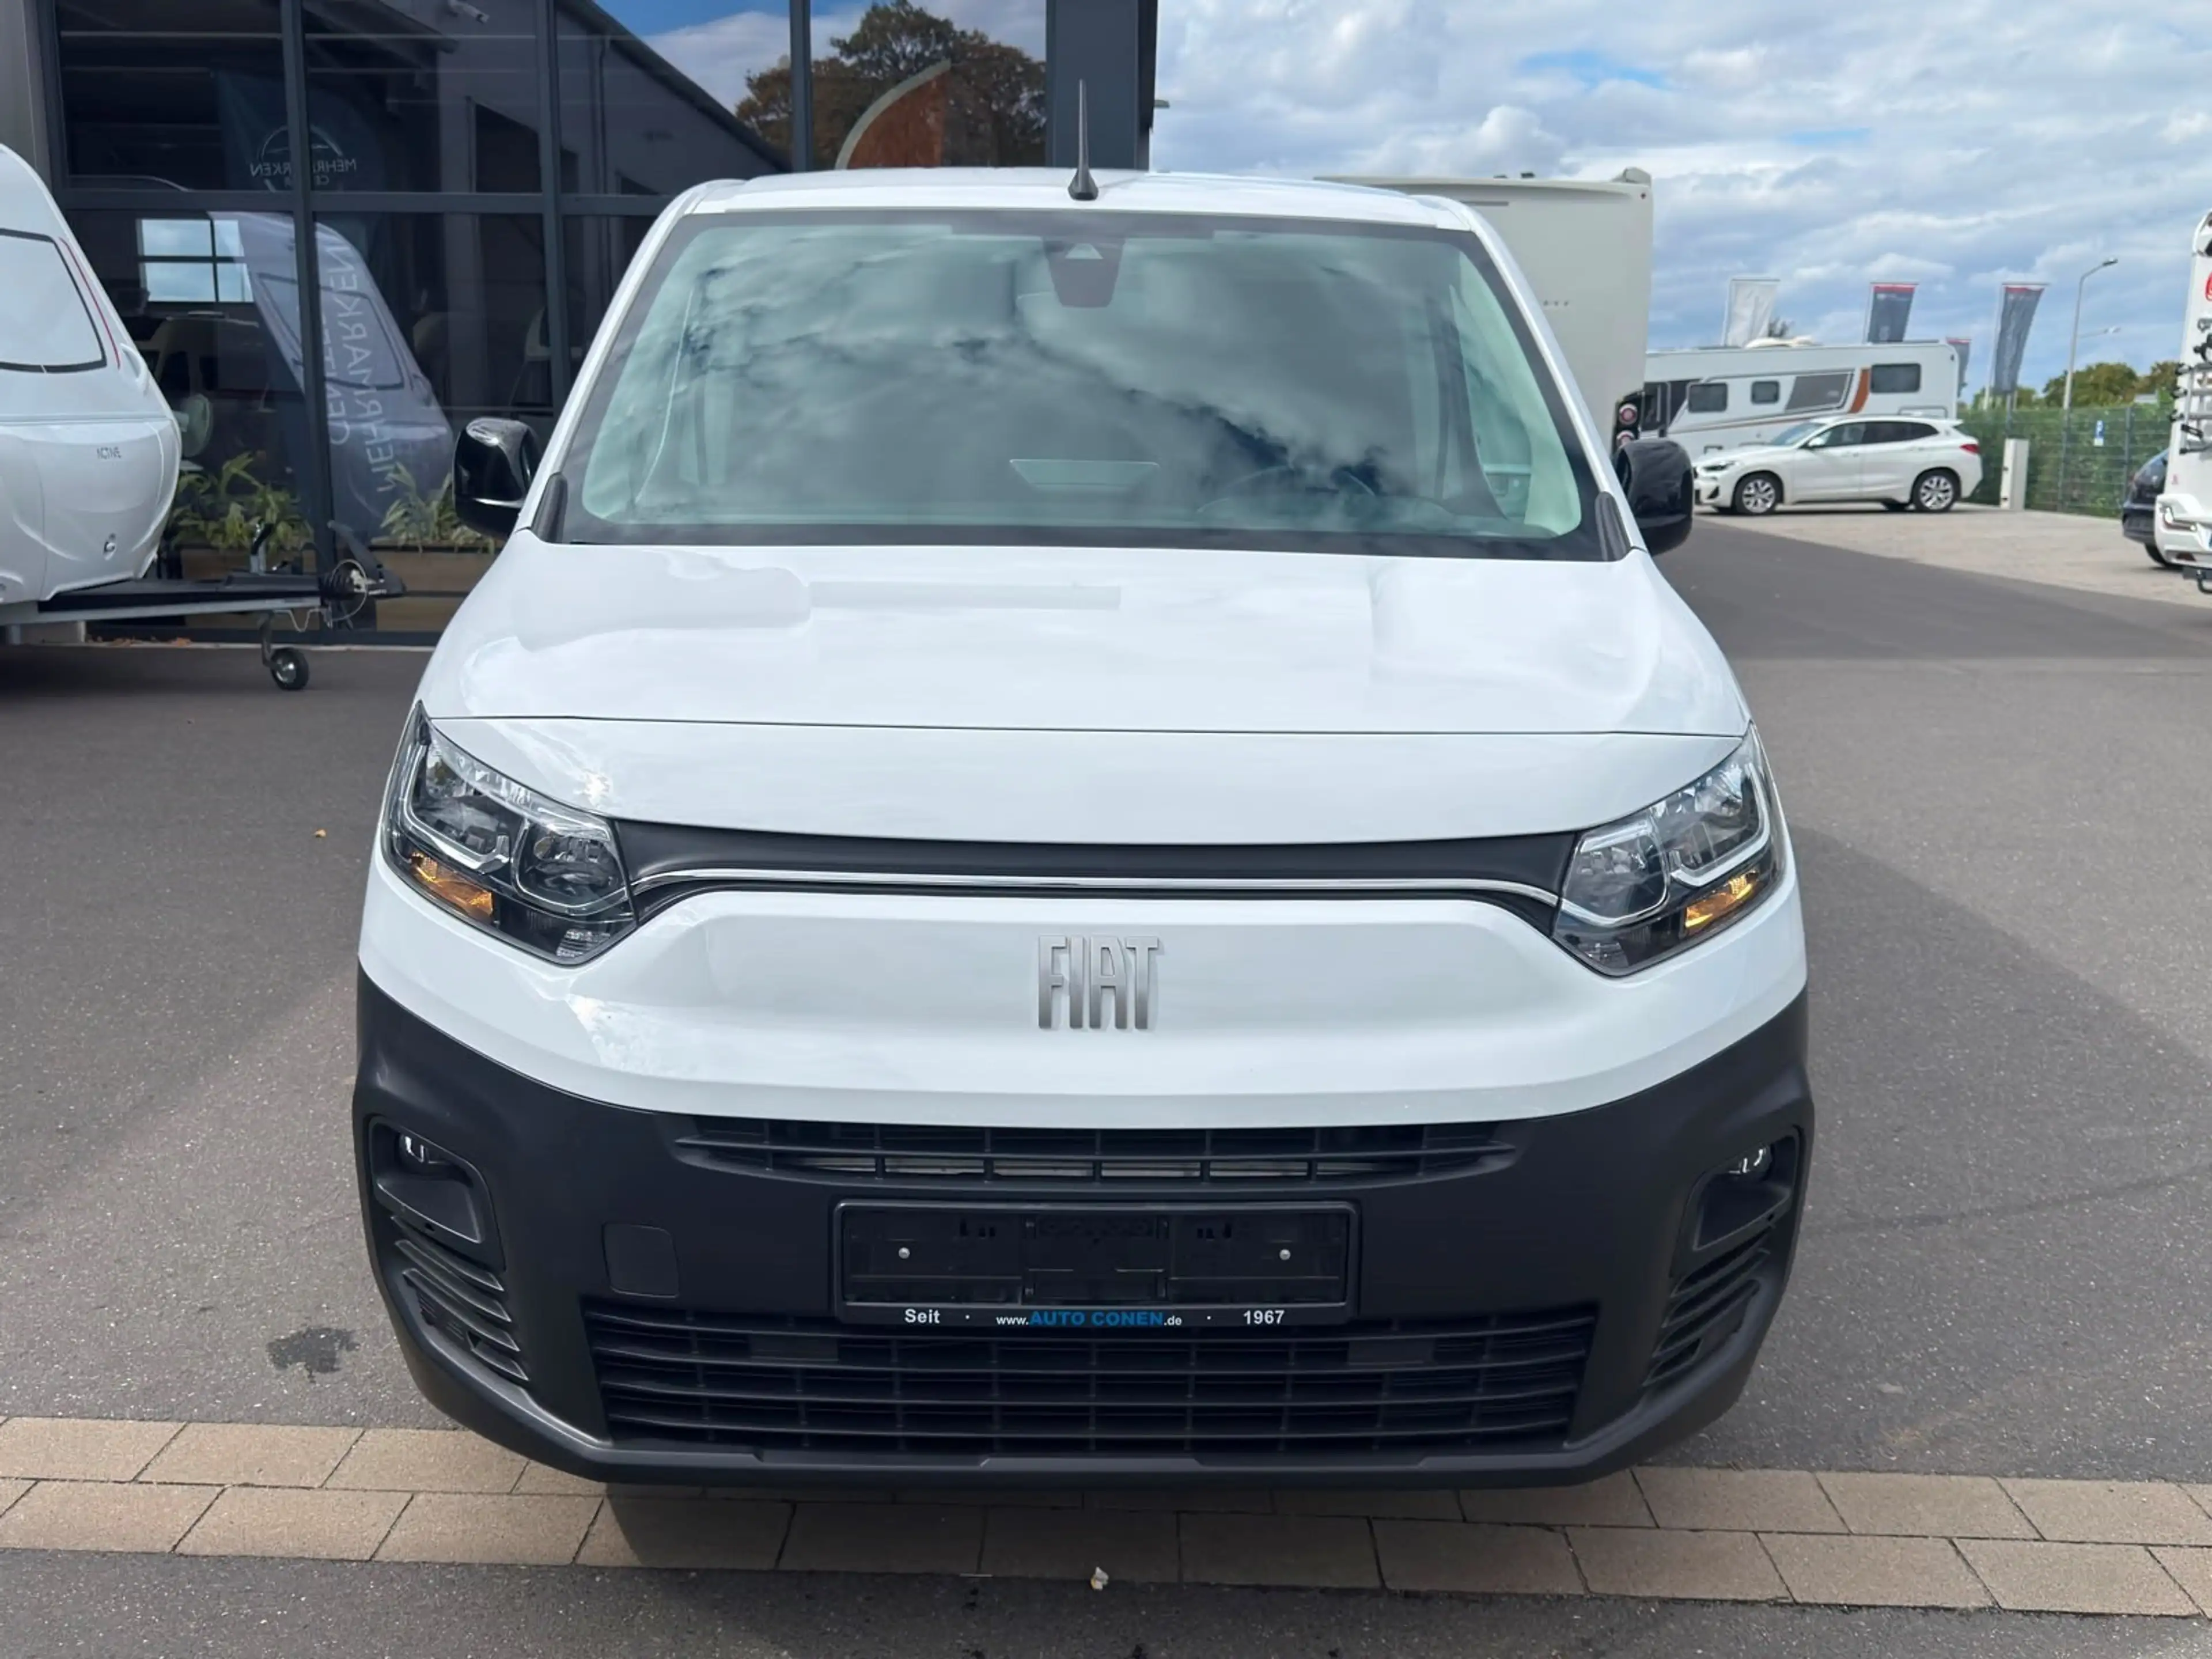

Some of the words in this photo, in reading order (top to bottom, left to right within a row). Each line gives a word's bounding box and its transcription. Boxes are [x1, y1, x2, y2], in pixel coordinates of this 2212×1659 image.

[1039, 935, 1160, 1029] FIAT
[904, 1308, 940, 1324] Seit
[1243, 1310, 1285, 1325] 1967
